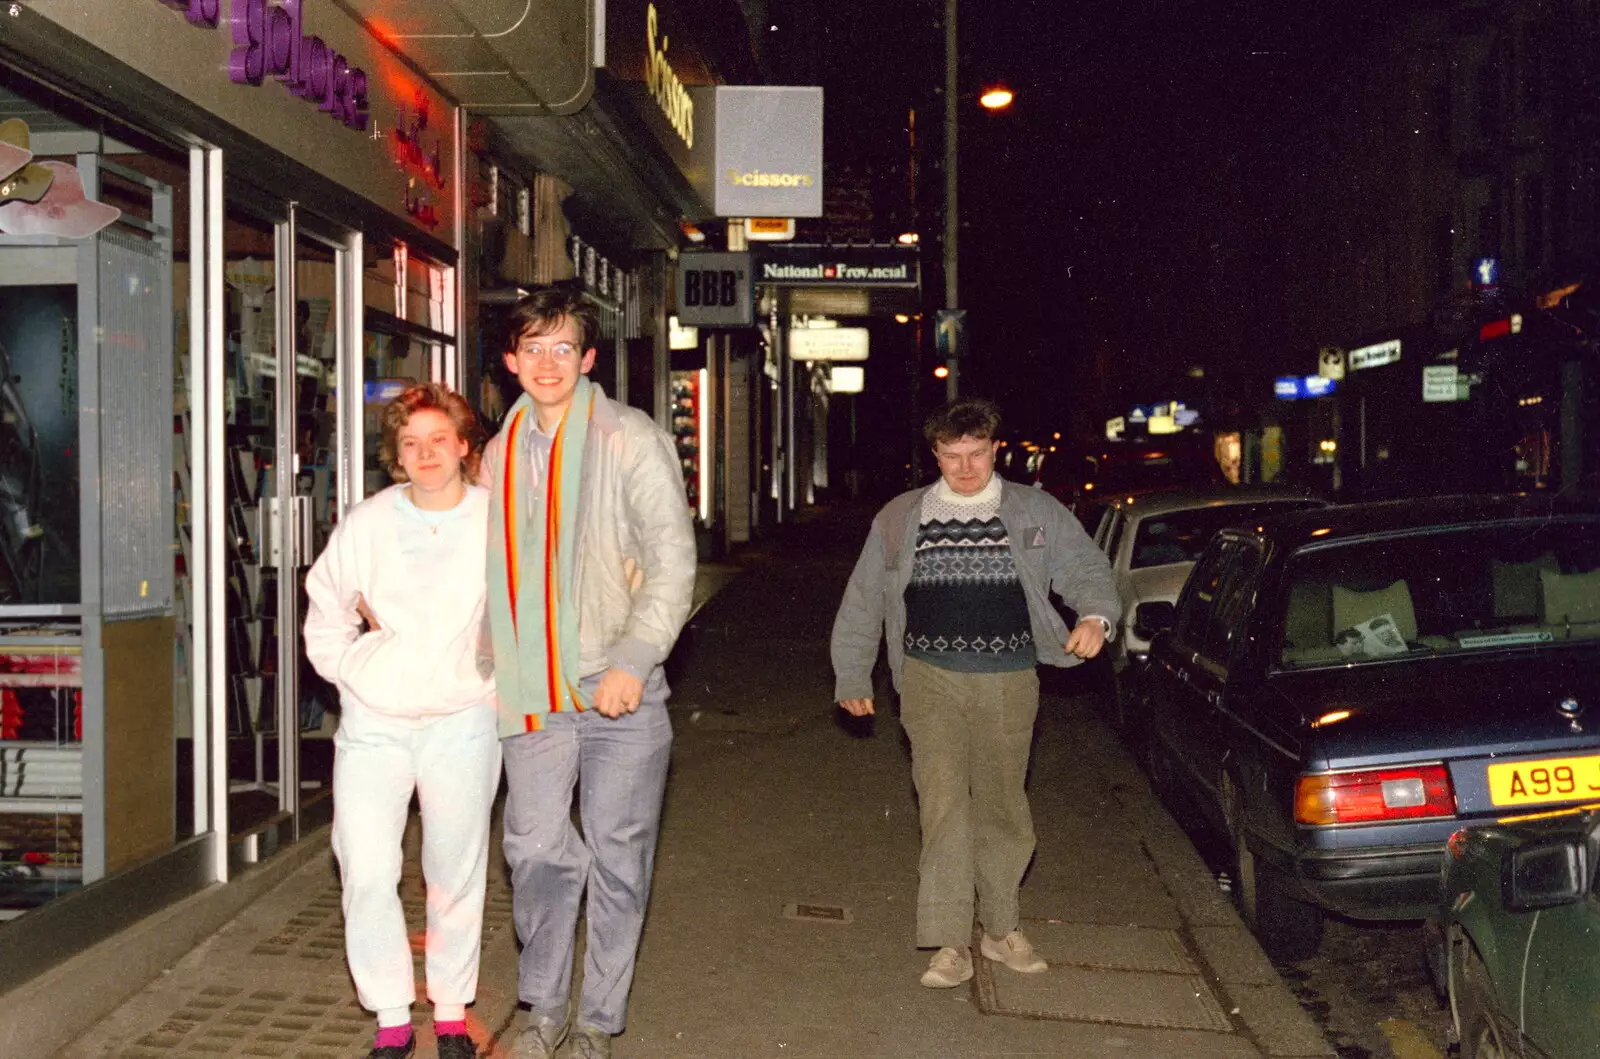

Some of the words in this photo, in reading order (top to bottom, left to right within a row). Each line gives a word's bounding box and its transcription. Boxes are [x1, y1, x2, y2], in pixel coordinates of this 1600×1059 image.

[725, 168, 813, 187] Scissors
[763, 263, 824, 279] National
[1510, 766, 1575, 798] A99
